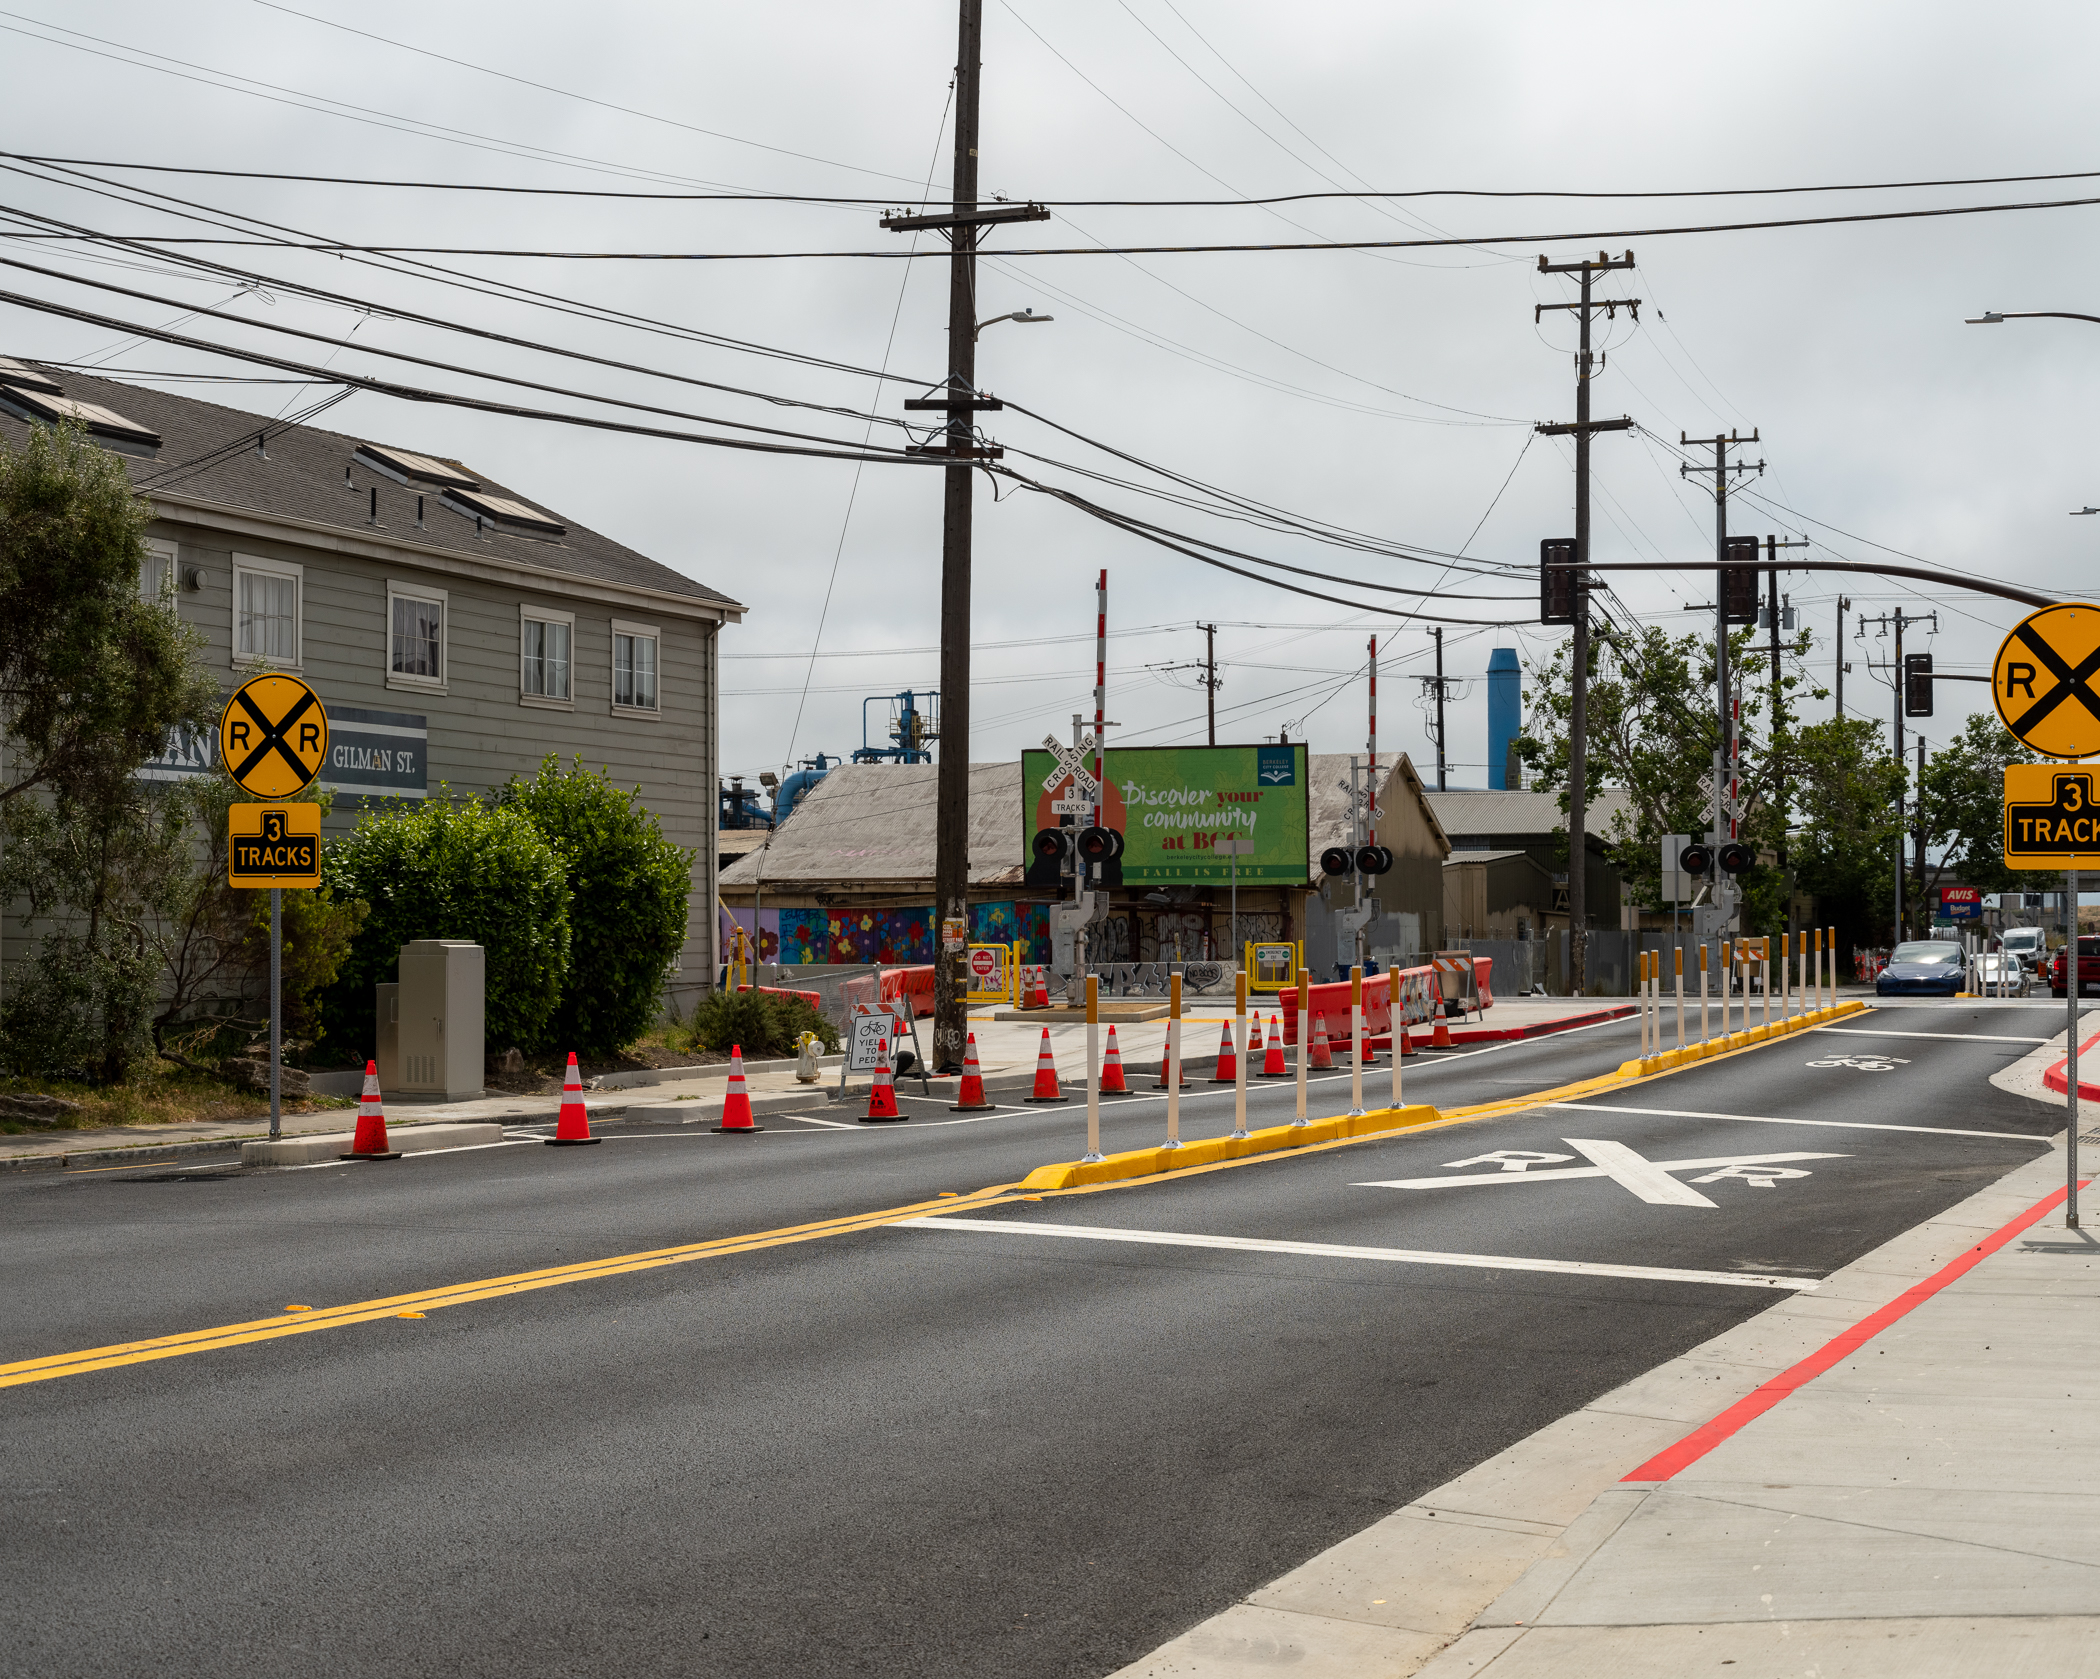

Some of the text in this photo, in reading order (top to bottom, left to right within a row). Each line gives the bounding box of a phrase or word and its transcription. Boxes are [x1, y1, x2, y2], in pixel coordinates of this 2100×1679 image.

[2006, 662, 2037, 698] R
[230, 721, 320, 752] R R
[333, 745, 392, 771] GILMAN
[397, 751, 416, 773] ST.
[1045, 737, 1065, 760] RAIL
[1047, 737, 1093, 788] CROSSING
[1072, 766, 1095, 789] ROAD
[1068, 789, 1075, 799] 3
[1119, 780, 1264, 809] Discover your
[2063, 783, 2082, 812] 3
[267, 818, 281, 842] 3
[1143, 806, 1257, 836] community
[1162, 834, 1186, 850] at
[238, 847, 311, 866] TRACKS
[1143, 867, 1264, 877] FALL IS FREE
[1947, 890, 1974, 900] AVIS
[1950, 904, 1971, 912] Budget
